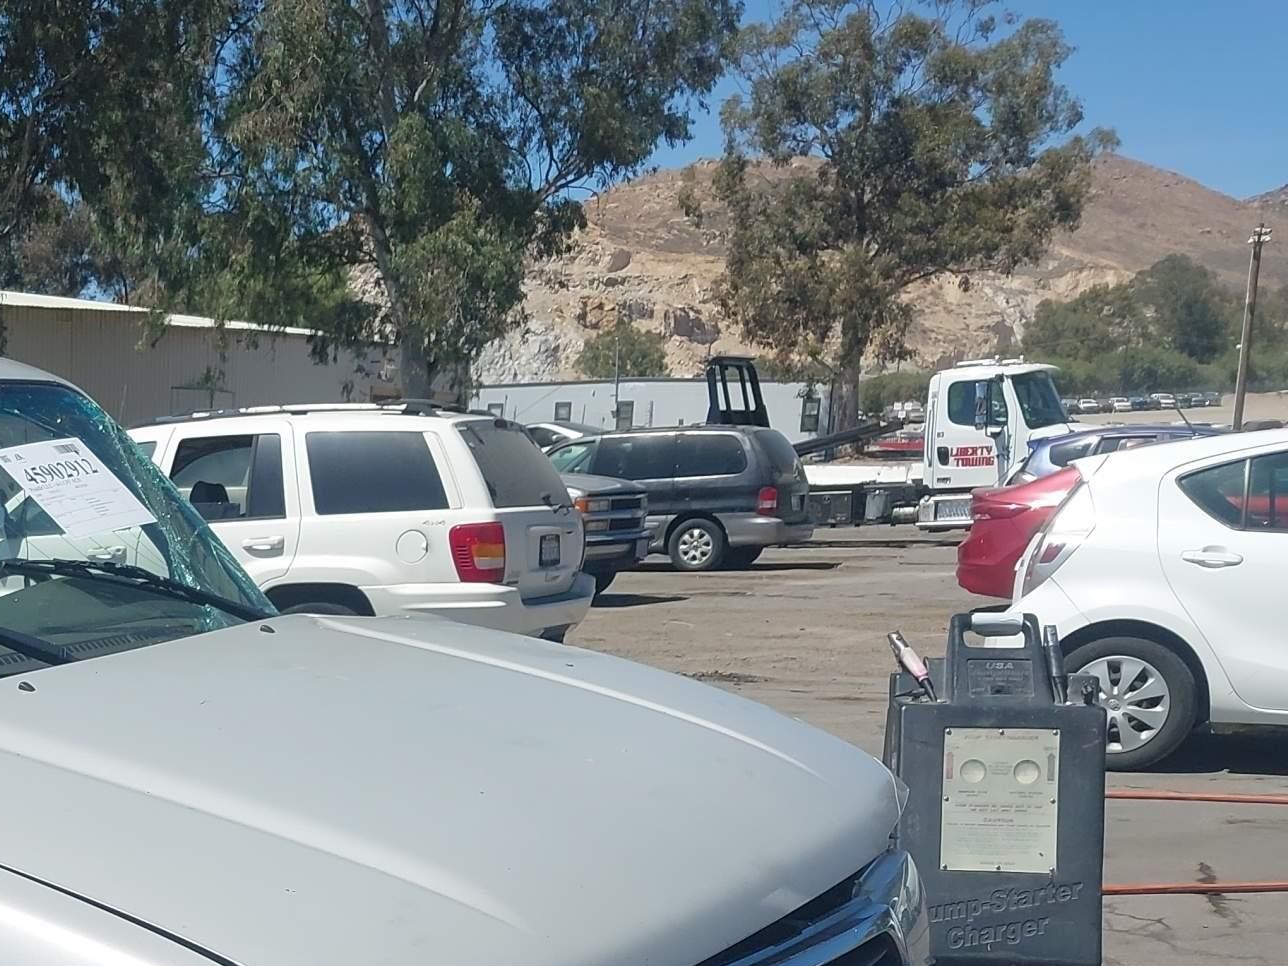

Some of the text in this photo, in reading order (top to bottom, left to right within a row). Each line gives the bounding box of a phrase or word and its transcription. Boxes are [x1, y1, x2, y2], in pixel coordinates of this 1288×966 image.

[951, 446, 993, 457] LIBERTY
[954, 457, 995, 467] TOWING
[24, 458, 99, 485] 45902912
[929, 881, 1083, 924] ump-Starter
[947, 917, 1050, 950] Charger
